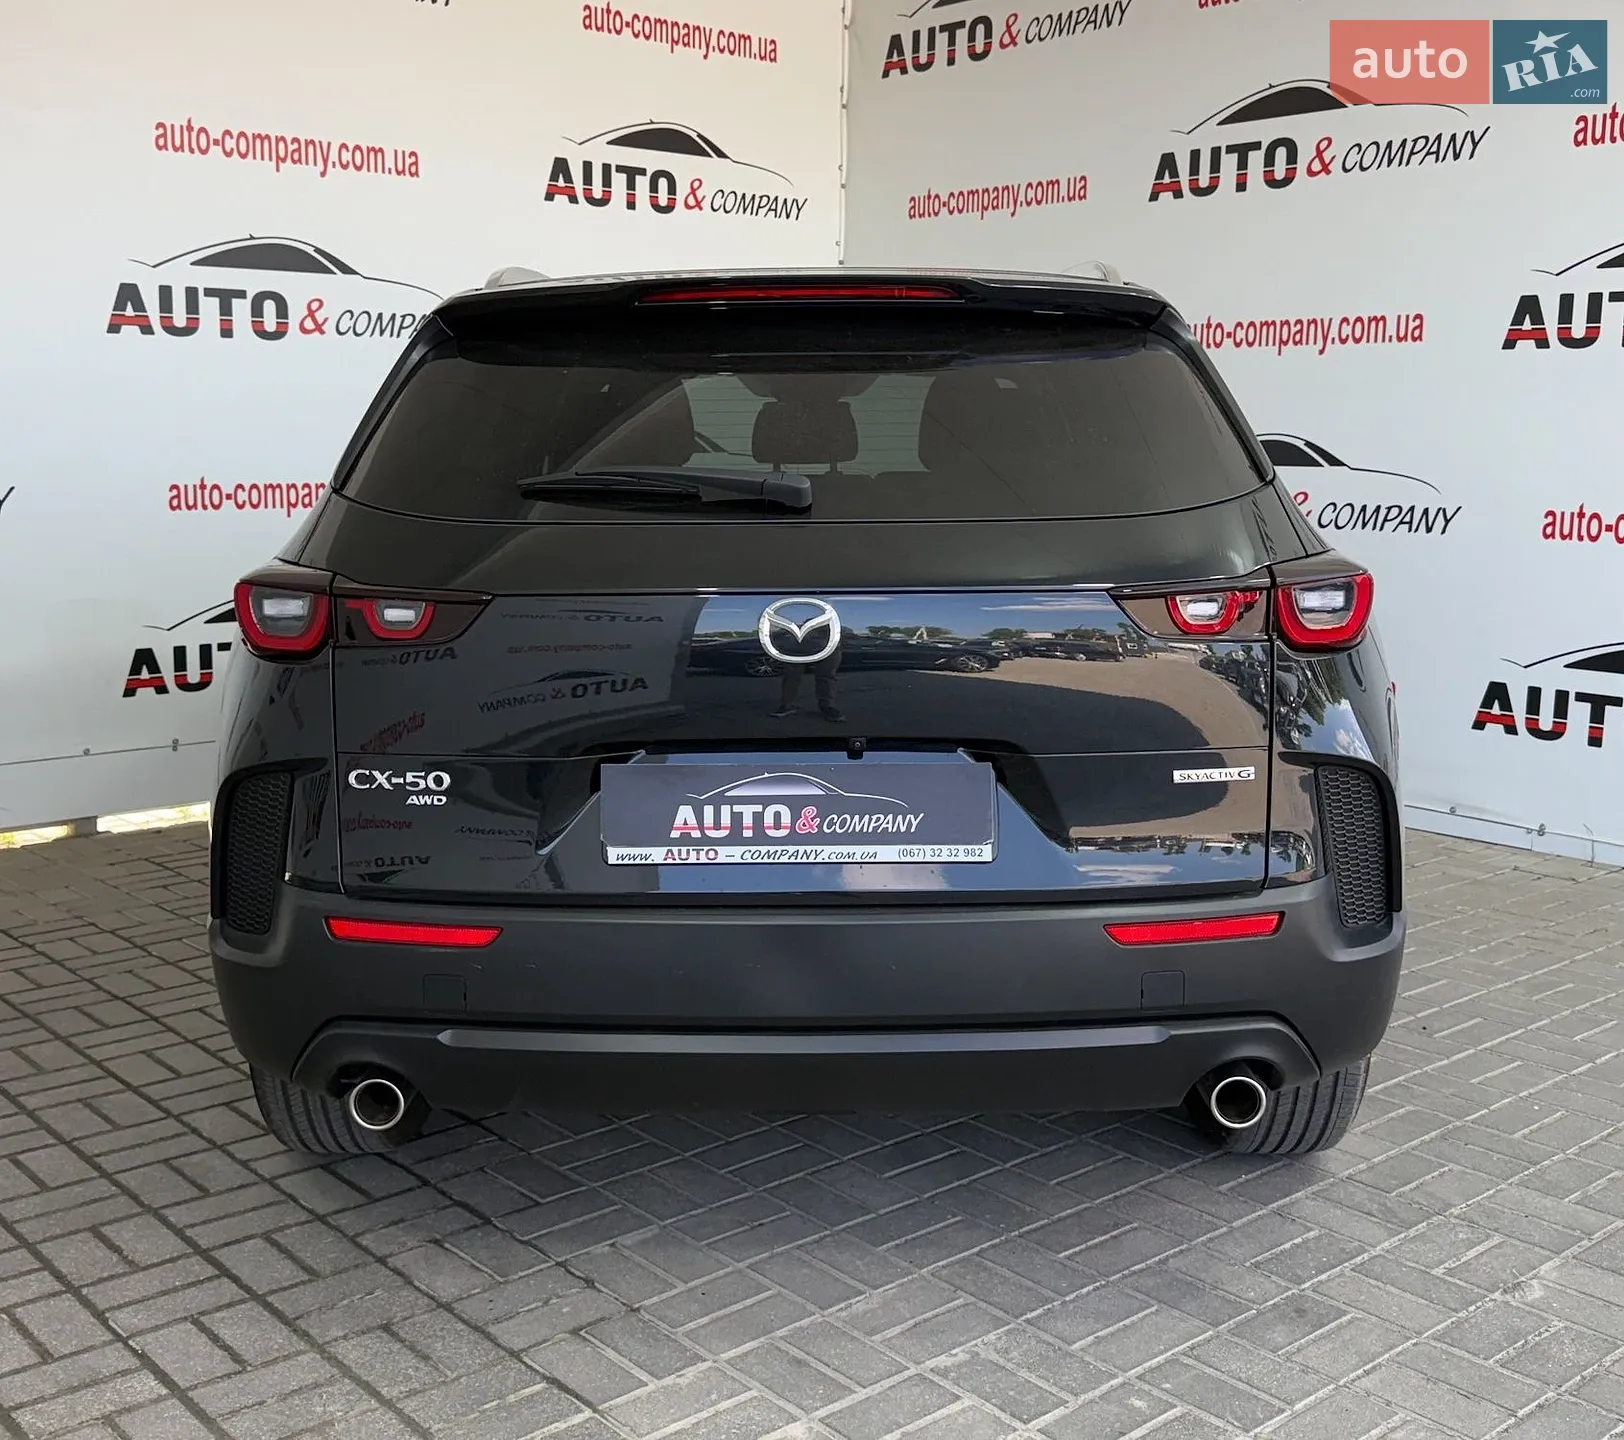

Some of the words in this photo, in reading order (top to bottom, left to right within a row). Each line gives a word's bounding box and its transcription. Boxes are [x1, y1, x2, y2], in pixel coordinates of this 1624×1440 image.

[583, 3, 777, 63] auto-company.com.ua
[882, 15, 993, 79] AUTO
[998, 12, 1021, 50] &
[1024, 0, 1131, 44] COMPANY
[1573, 102, 1624, 147] aut
[155, 117, 419, 178] auto-company.com.ua
[1148, 137, 1298, 202] AUTO
[1306, 136, 1336, 178] &
[1341, 125, 1491, 173] COMPANY
[544, 156, 677, 214] AUTO
[683, 178, 706, 211] &
[710, 188, 808, 221] COMPANY
[908, 175, 1087, 220] auto-company.com.ua
[106, 282, 289, 341] AUTO
[298, 298, 329, 335] &
[1187, 313, 1424, 356] uto-company.com.ua
[1317, 502, 1462, 535] COMPANY
[1471, 681, 1623, 748] AUT
[348, 768, 451, 791] CX-50
[405, 794, 447, 806] AWD
[669, 804, 792, 838] AUTO
[795, 806, 820, 834] &
[822, 812, 925, 834] COMPANY
[663, 848, 719, 861] AUTO
[897, 847, 926, 860] (067)
[930, 847, 943, 859] 32
[946, 847, 960, 859] 32
[963, 846, 984, 858] 982
